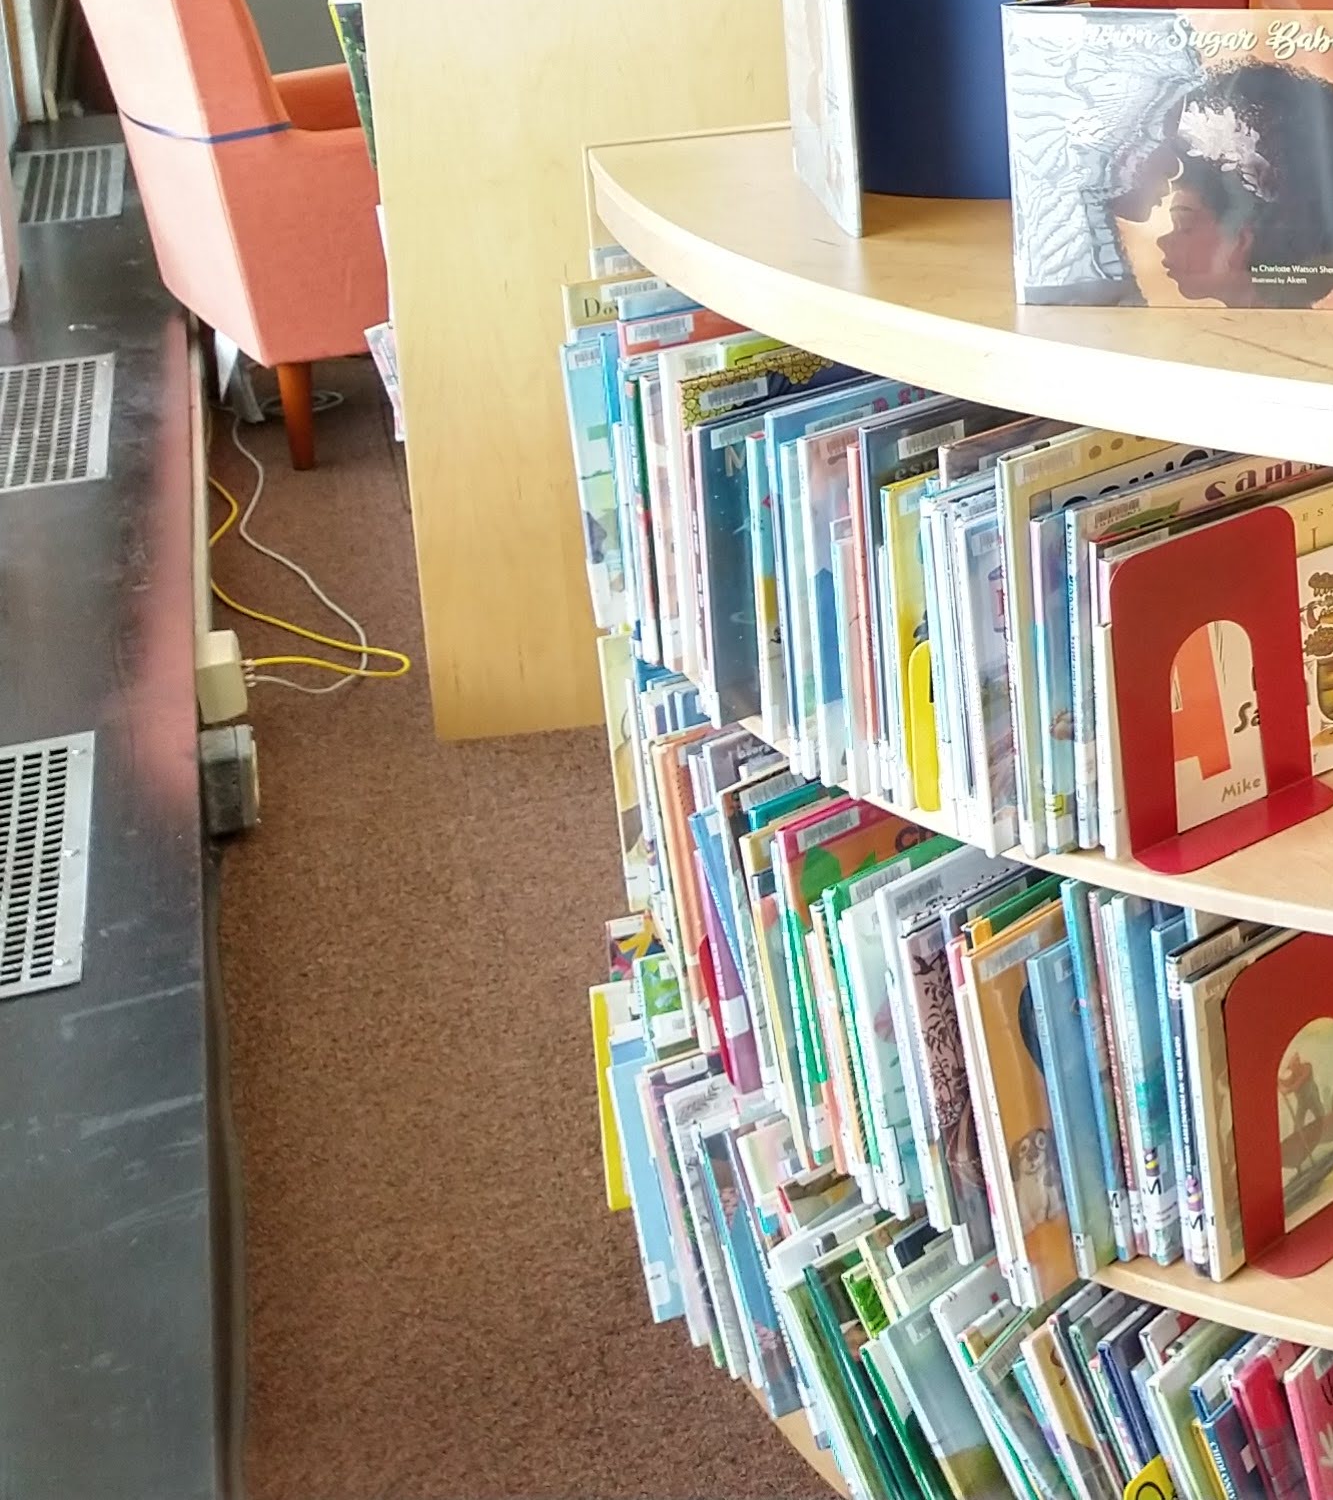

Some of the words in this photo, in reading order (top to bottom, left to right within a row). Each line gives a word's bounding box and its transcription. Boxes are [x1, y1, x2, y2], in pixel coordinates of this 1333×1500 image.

[1165, 16, 1259, 58] Sugar
[1259, 264, 1291, 273] Charlotte
[1291, 265, 1318, 274] Watson
[1286, 276, 1308, 284] Akem
[1221, 776, 1262, 803] Mike
